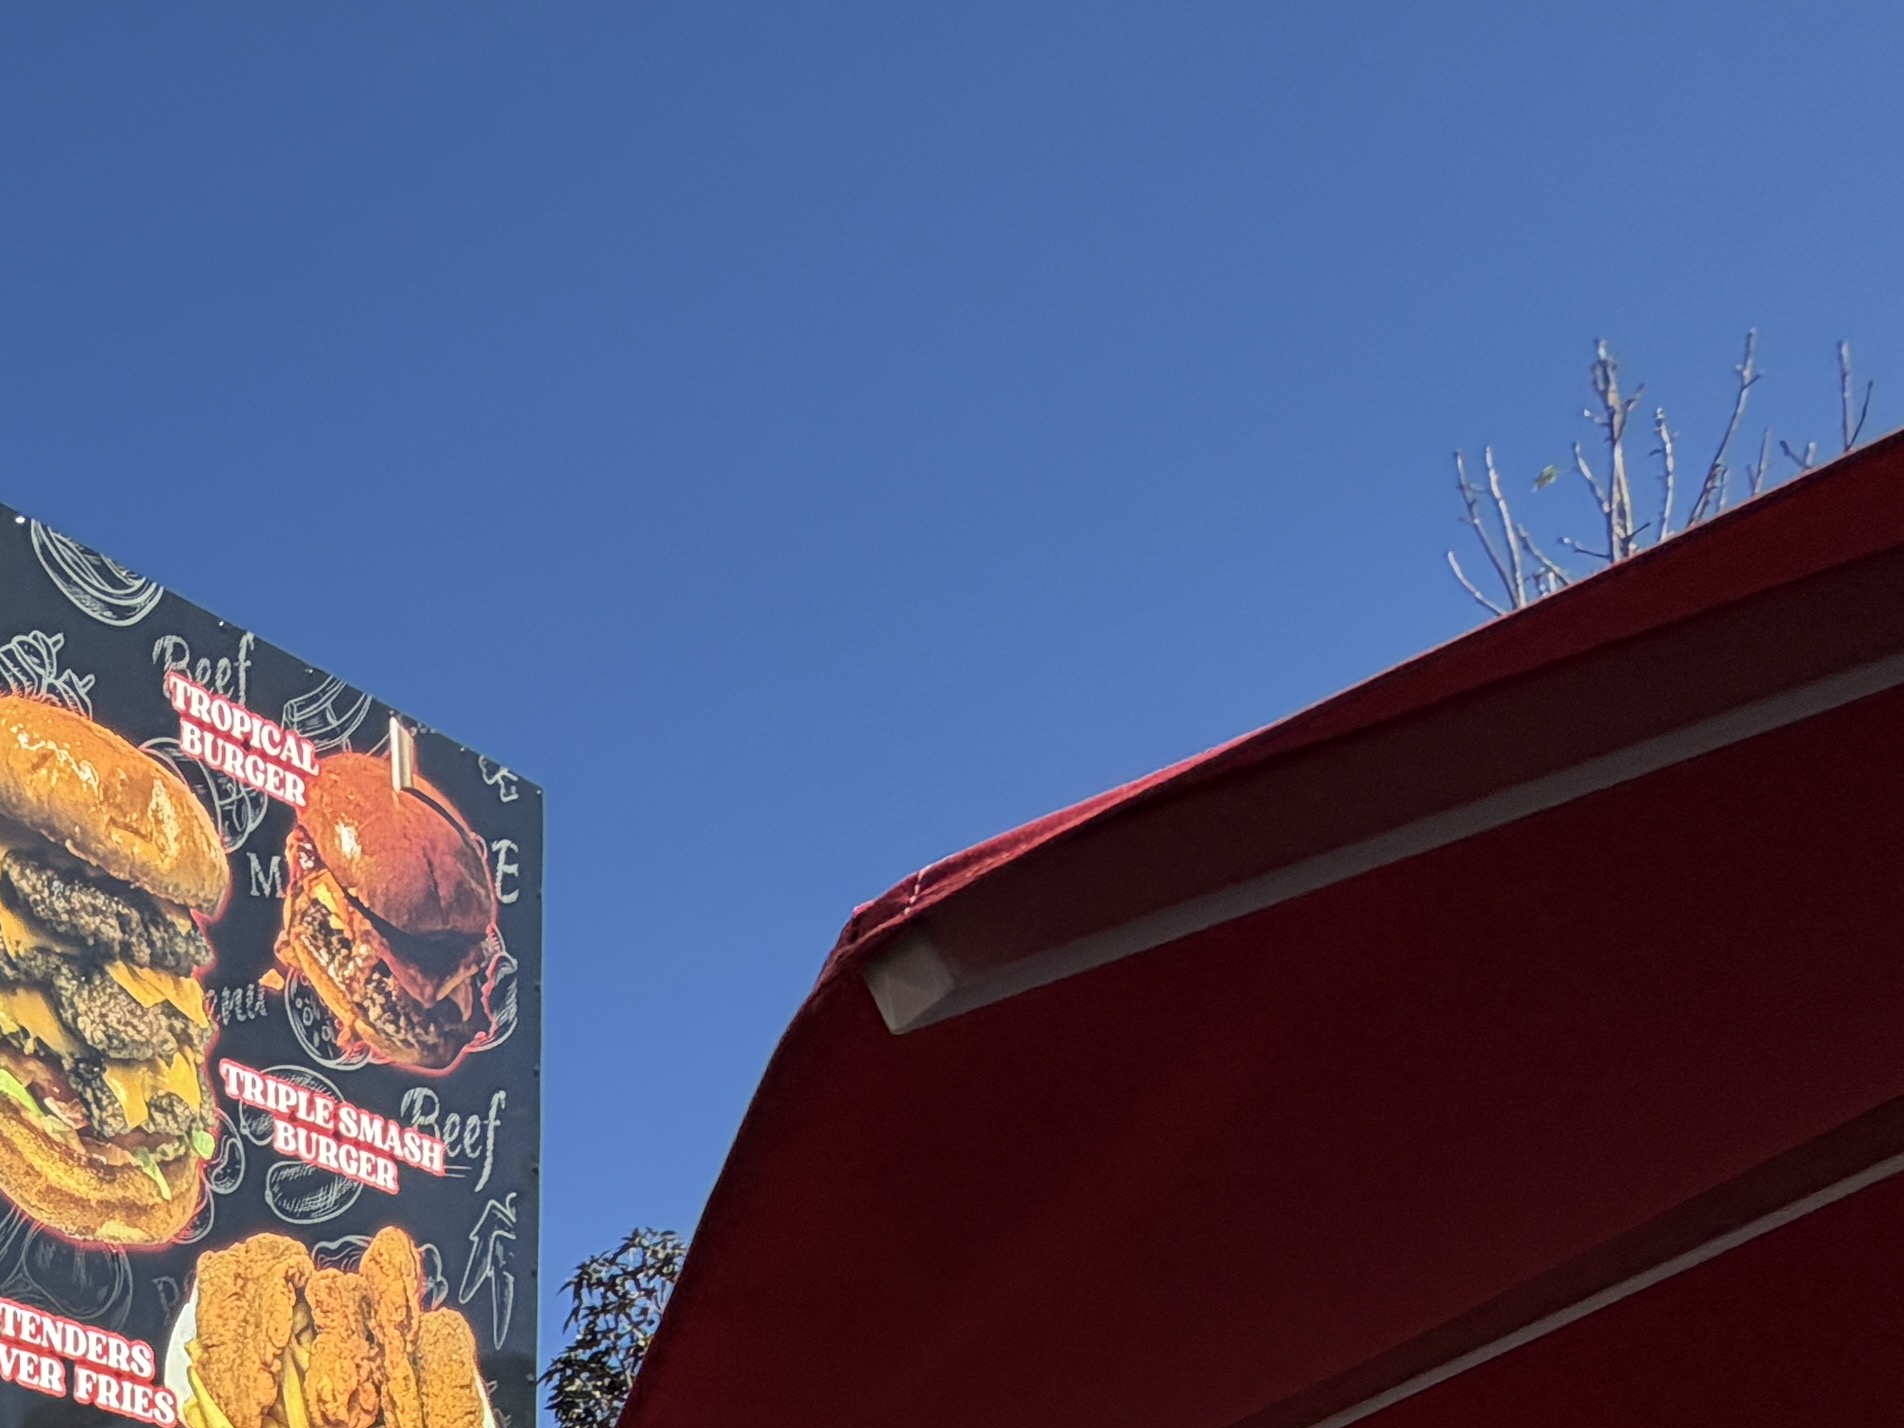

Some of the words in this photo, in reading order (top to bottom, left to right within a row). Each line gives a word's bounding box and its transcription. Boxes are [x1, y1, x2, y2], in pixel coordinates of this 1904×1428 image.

[169, 672, 319, 777] TROPICAL
[181, 720, 306, 807] BURGER
[221, 1061, 333, 1131] TRIPLE
[338, 1105, 445, 1169] SMASH
[275, 1126, 399, 1192] BURGER
[75, 1368, 178, 1426] FRIES
